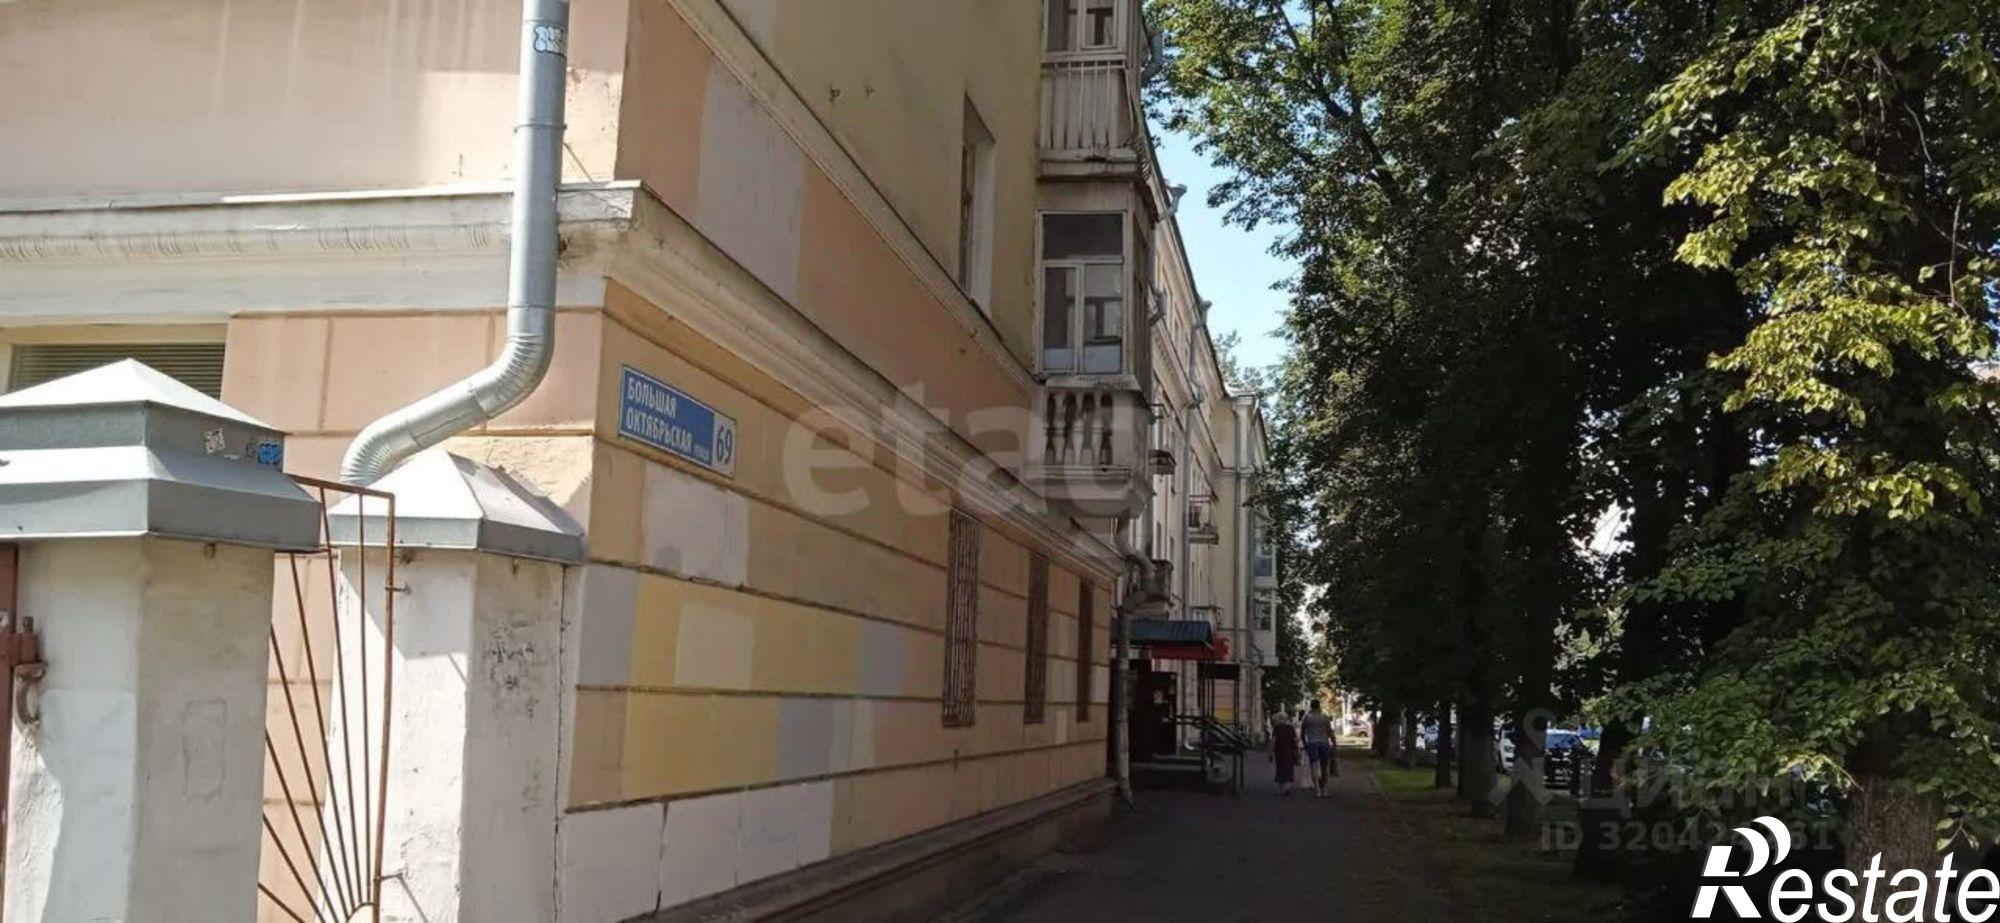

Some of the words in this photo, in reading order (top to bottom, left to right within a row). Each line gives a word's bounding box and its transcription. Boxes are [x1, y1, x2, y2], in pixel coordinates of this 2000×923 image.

[626, 377, 677, 419] БОЛЬШАЯ
[626, 407, 693, 454] ОКТЯБРЬСКАЯ
[716, 425, 733, 465] 69
